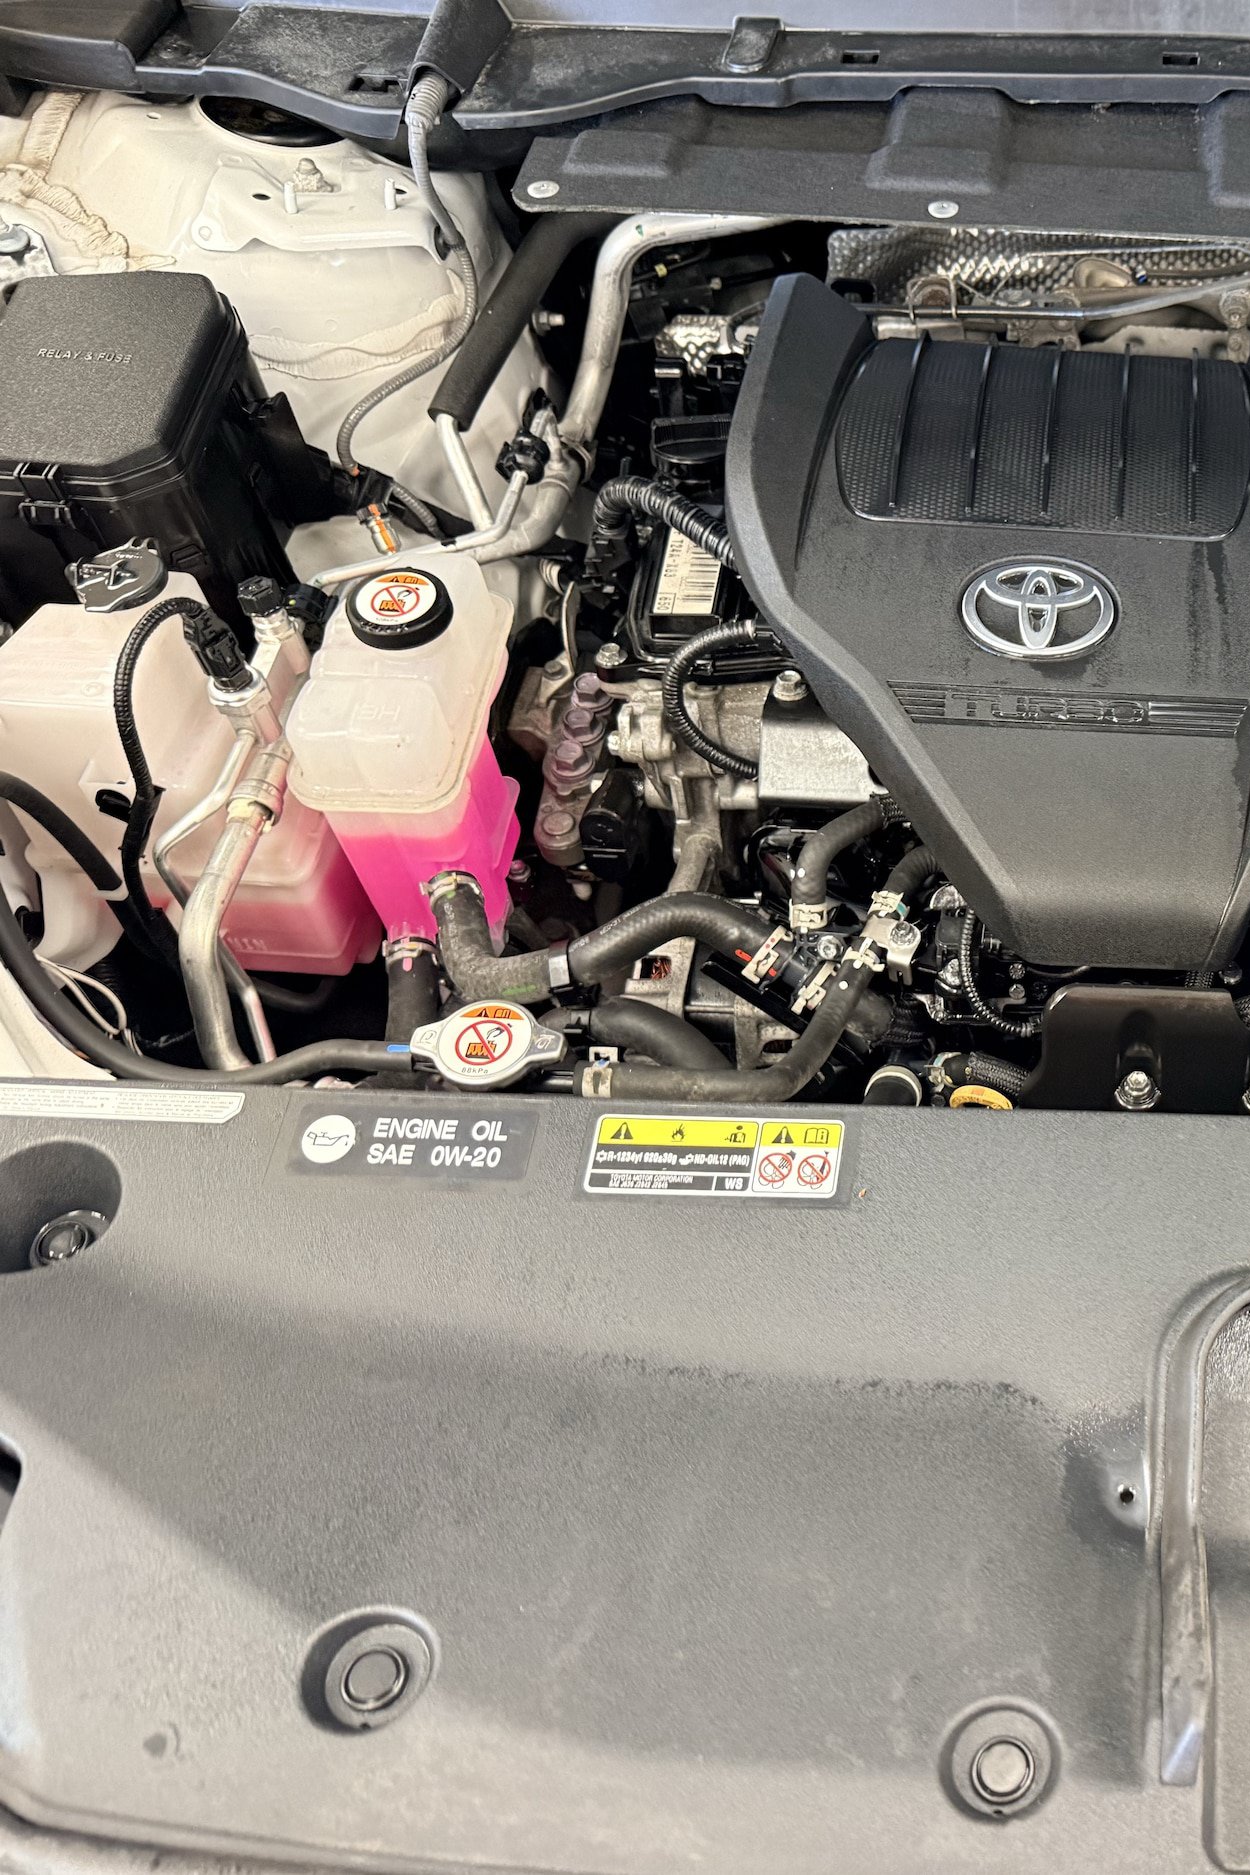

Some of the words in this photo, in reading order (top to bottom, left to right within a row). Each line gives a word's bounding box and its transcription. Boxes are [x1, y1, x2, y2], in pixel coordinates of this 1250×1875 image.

[37, 348, 81, 360] RELAY
[83, 351, 93, 361] &
[97, 352, 133, 363] FUSE
[950, 693, 1146, 723] TURBO
[461, 1067, 489, 1075] 88kPa
[373, 1117, 459, 1140] ENGINE
[471, 1120, 508, 1142] OIL
[367, 1143, 415, 1165] SAE
[430, 1145, 502, 1168] 0W-20
[610, 1173, 632, 1182] TOYOTA
